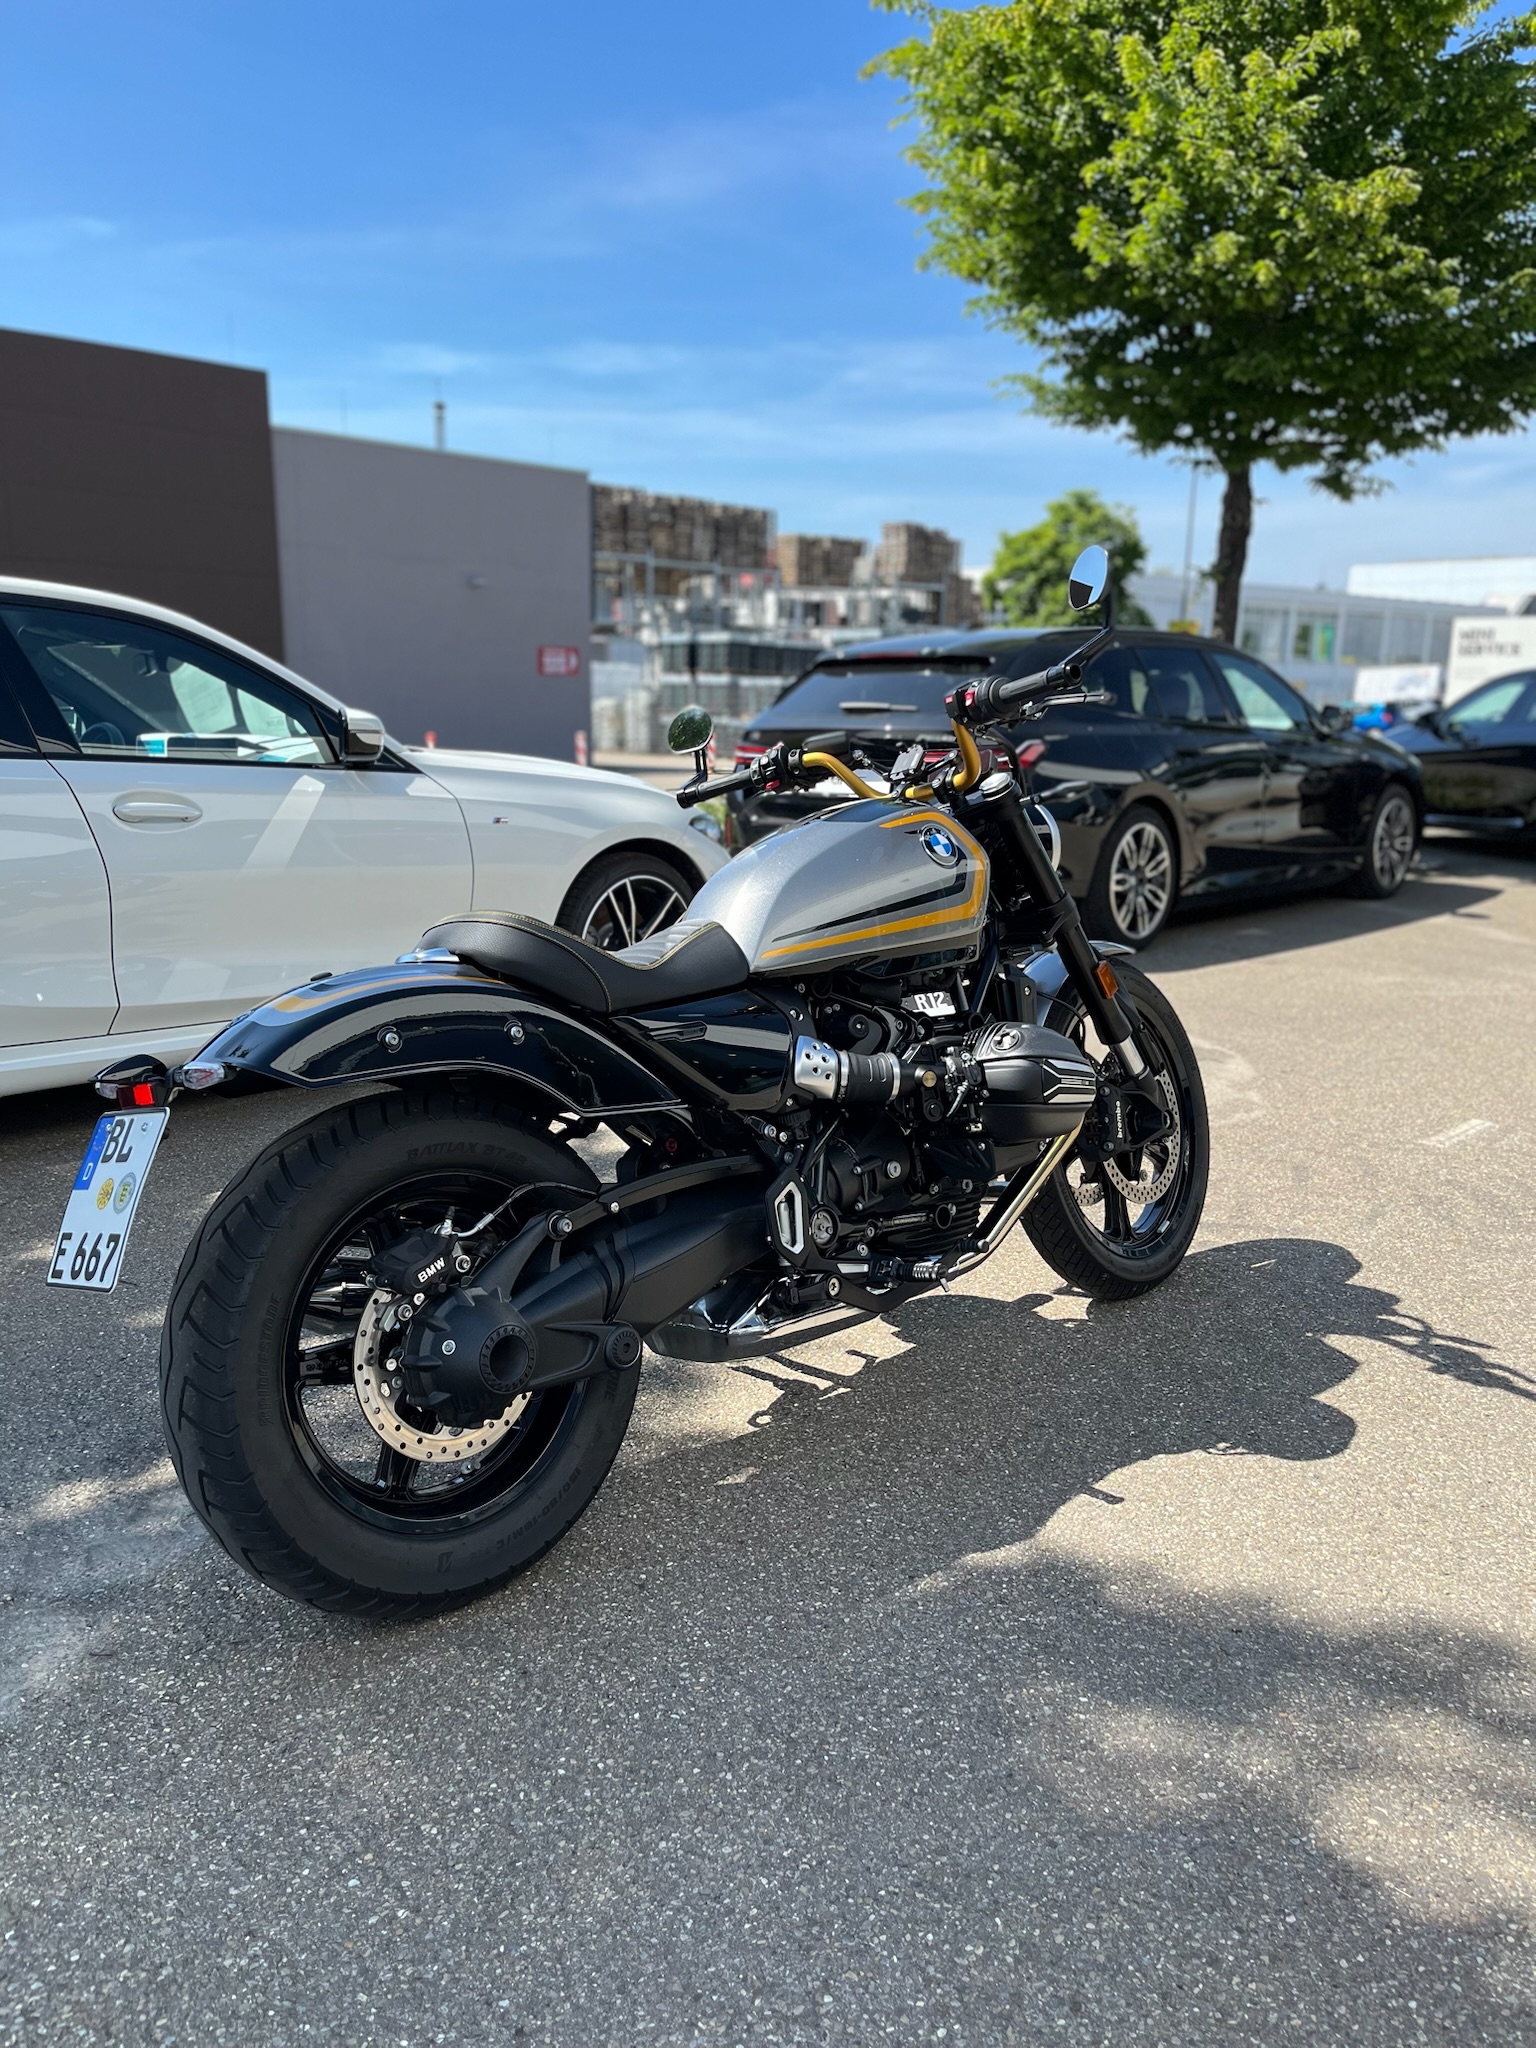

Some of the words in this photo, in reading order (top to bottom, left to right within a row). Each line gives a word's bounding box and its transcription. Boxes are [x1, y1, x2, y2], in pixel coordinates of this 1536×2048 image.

[914, 991, 948, 1010] R12
[1115, 1100, 1123, 1138] brembo
[100, 1117, 135, 1163] BL
[82, 1162, 93, 1181] D
[51, 1232, 73, 1279] E
[70, 1232, 121, 1282] 667
[417, 1257, 445, 1283] BMW
